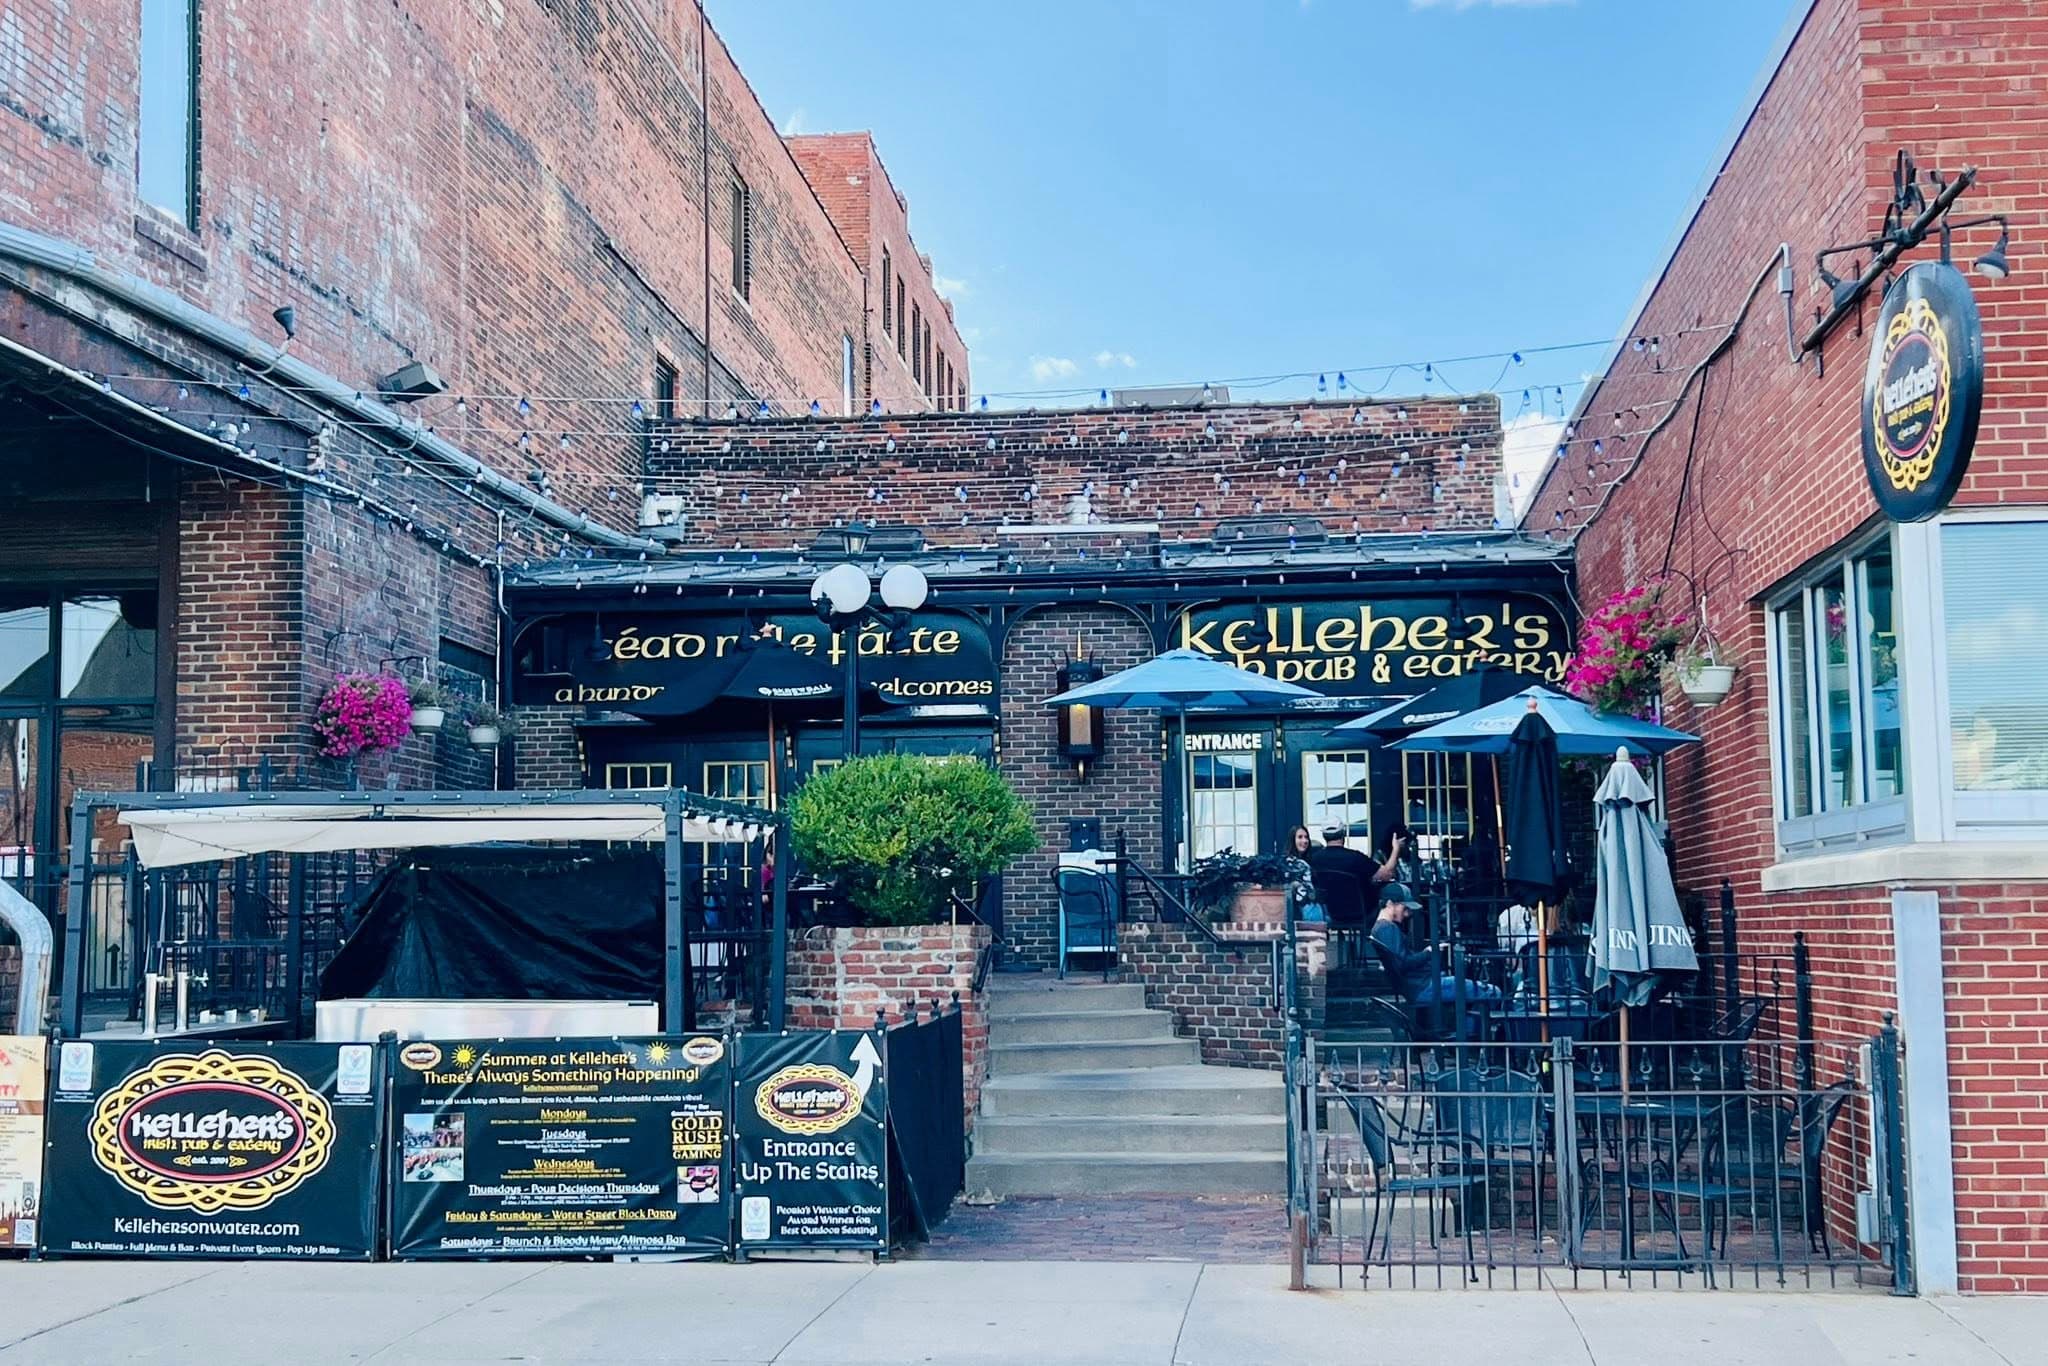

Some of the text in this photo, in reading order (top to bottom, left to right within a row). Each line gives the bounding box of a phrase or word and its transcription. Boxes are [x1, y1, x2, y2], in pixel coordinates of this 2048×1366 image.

[1371, 653, 1391, 683] &
[555, 678, 993, 702] a hundr elcomes
[1184, 733, 1262, 751] ENTRANCE
[481, 1051, 638, 1067] Summer at Kelleher's
[422, 1071, 474, 1085] There's
[475, 1069, 530, 1085] Always
[531, 1068, 613, 1084] Something
[540, 1109, 587, 1121] Mondays
[130, 1109, 294, 1140] Kelleher's
[671, 1116, 723, 1131] GOLD
[541, 1129, 587, 1140] Tuesdays
[672, 1130, 721, 1144] RUSH
[212, 1139, 224, 1150] &
[763, 1138, 856, 1157] Entrance
[672, 1150, 722, 1159] GAMING
[533, 1158, 595, 1169] Wednesdays
[741, 1161, 879, 1185] Up The Stairs
[468, 1184, 522, 1196] Thursdays
[531, 1183, 555, 1194] Pour
[558, 1183, 605, 1194] Decisions
[606, 1182, 660, 1193] Thursdays
[445, 1211, 478, 1222] Friday
[479, 1211, 488, 1220] &
[490, 1210, 543, 1221] Saturdays
[552, 1209, 583, 1220] Water
[585, 1209, 617, 1219] Street
[619, 1208, 646, 1219] Block
[647, 1208, 677, 1219] Party
[776, 1205, 811, 1215] Peoria's
[852, 1204, 881, 1215] Choice
[114, 1217, 300, 1236] Kellehersonwater.com
[786, 1215, 872, 1225] Award Winner for
[780, 1225, 800, 1235] Best
[801, 1225, 841, 1235] Outdoor
[440, 1237, 494, 1248] Saturdays
[503, 1236, 541, 1247] Brunch
[543, 1236, 552, 1246] &
[553, 1235, 588, 1246] Bloody
[665, 1234, 687, 1245] Bar
